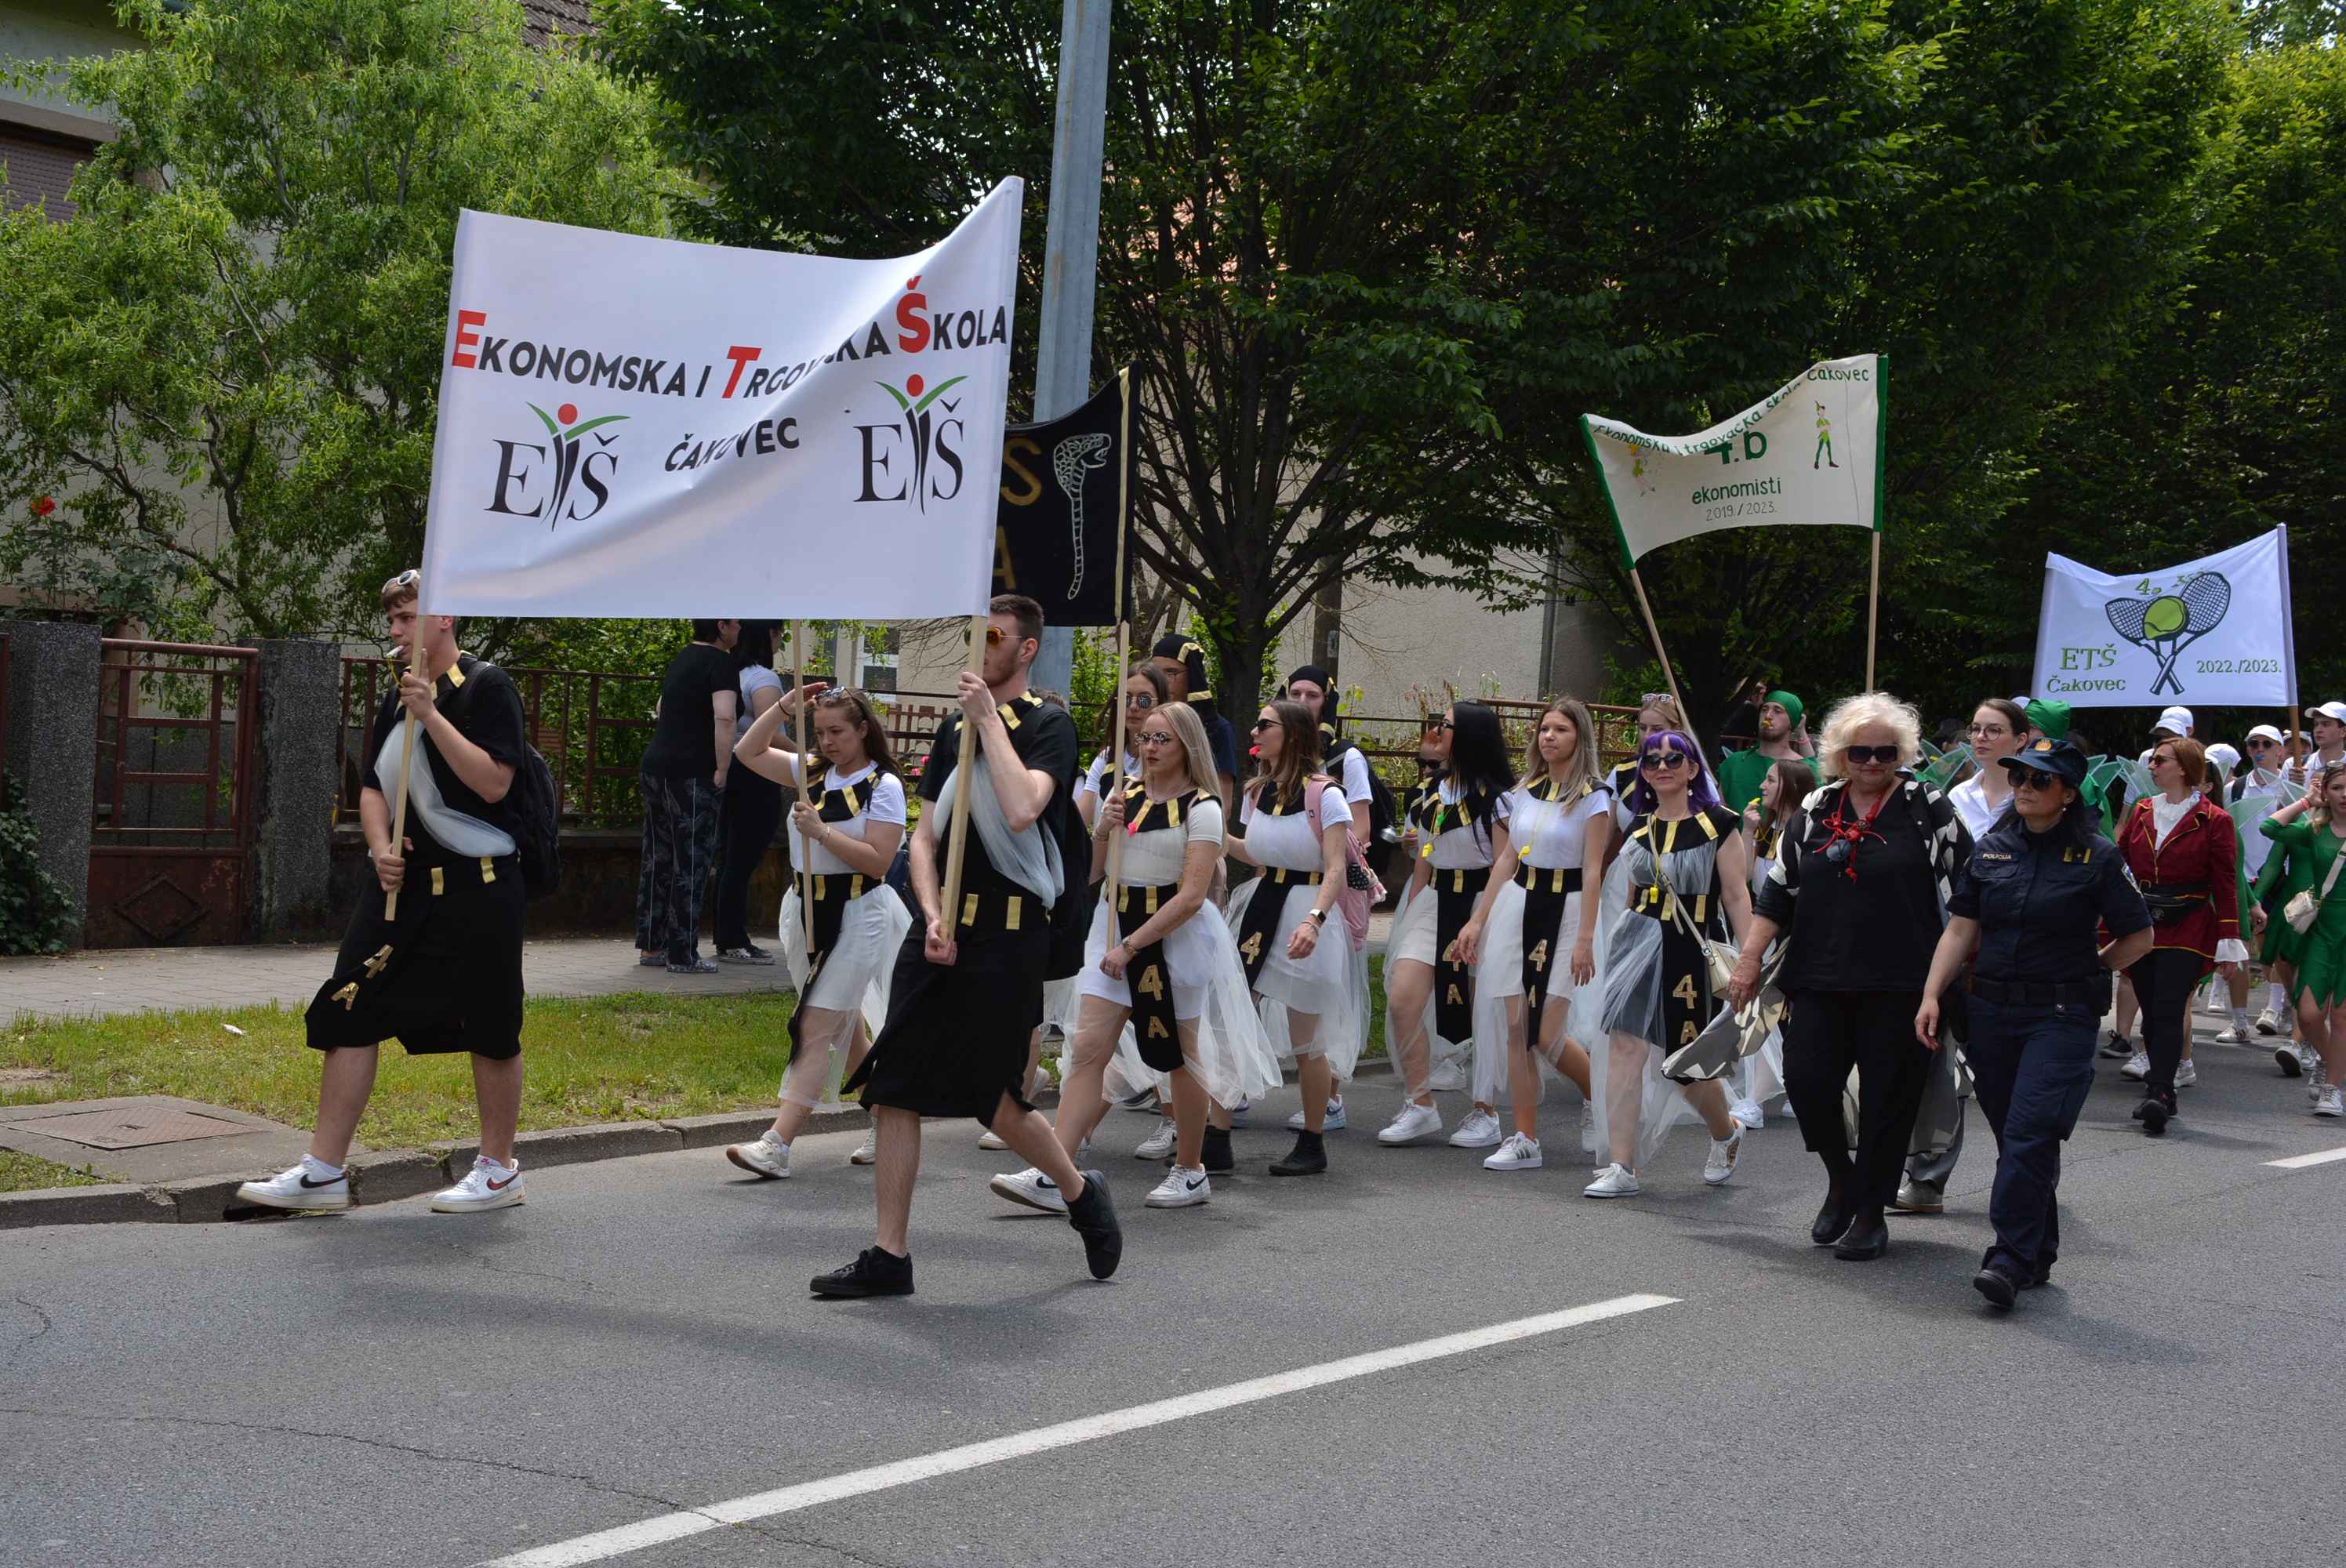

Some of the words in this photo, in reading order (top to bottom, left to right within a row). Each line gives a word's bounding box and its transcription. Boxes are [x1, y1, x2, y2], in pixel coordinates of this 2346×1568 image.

[451, 309, 685, 397] EKONOMSKA
[695, 365, 712, 397] I
[896, 274, 1007, 354] ŠKOLA
[664, 417, 800, 472] ČAKOVEC
[1692, 477, 1781, 504] ekonomisti
[2060, 644, 2118, 670] ETŠ
[2196, 659, 2282, 673] 2022./2023.
[2046, 675, 2126, 693] Čakovec
[1240, 931, 1262, 964] 4
[1528, 939, 1549, 972] 4
[1138, 964, 1164, 1001] 4
[1446, 983, 1464, 1005] A
[1672, 975, 1698, 1009] 4
[1147, 1016, 1169, 1039] A
